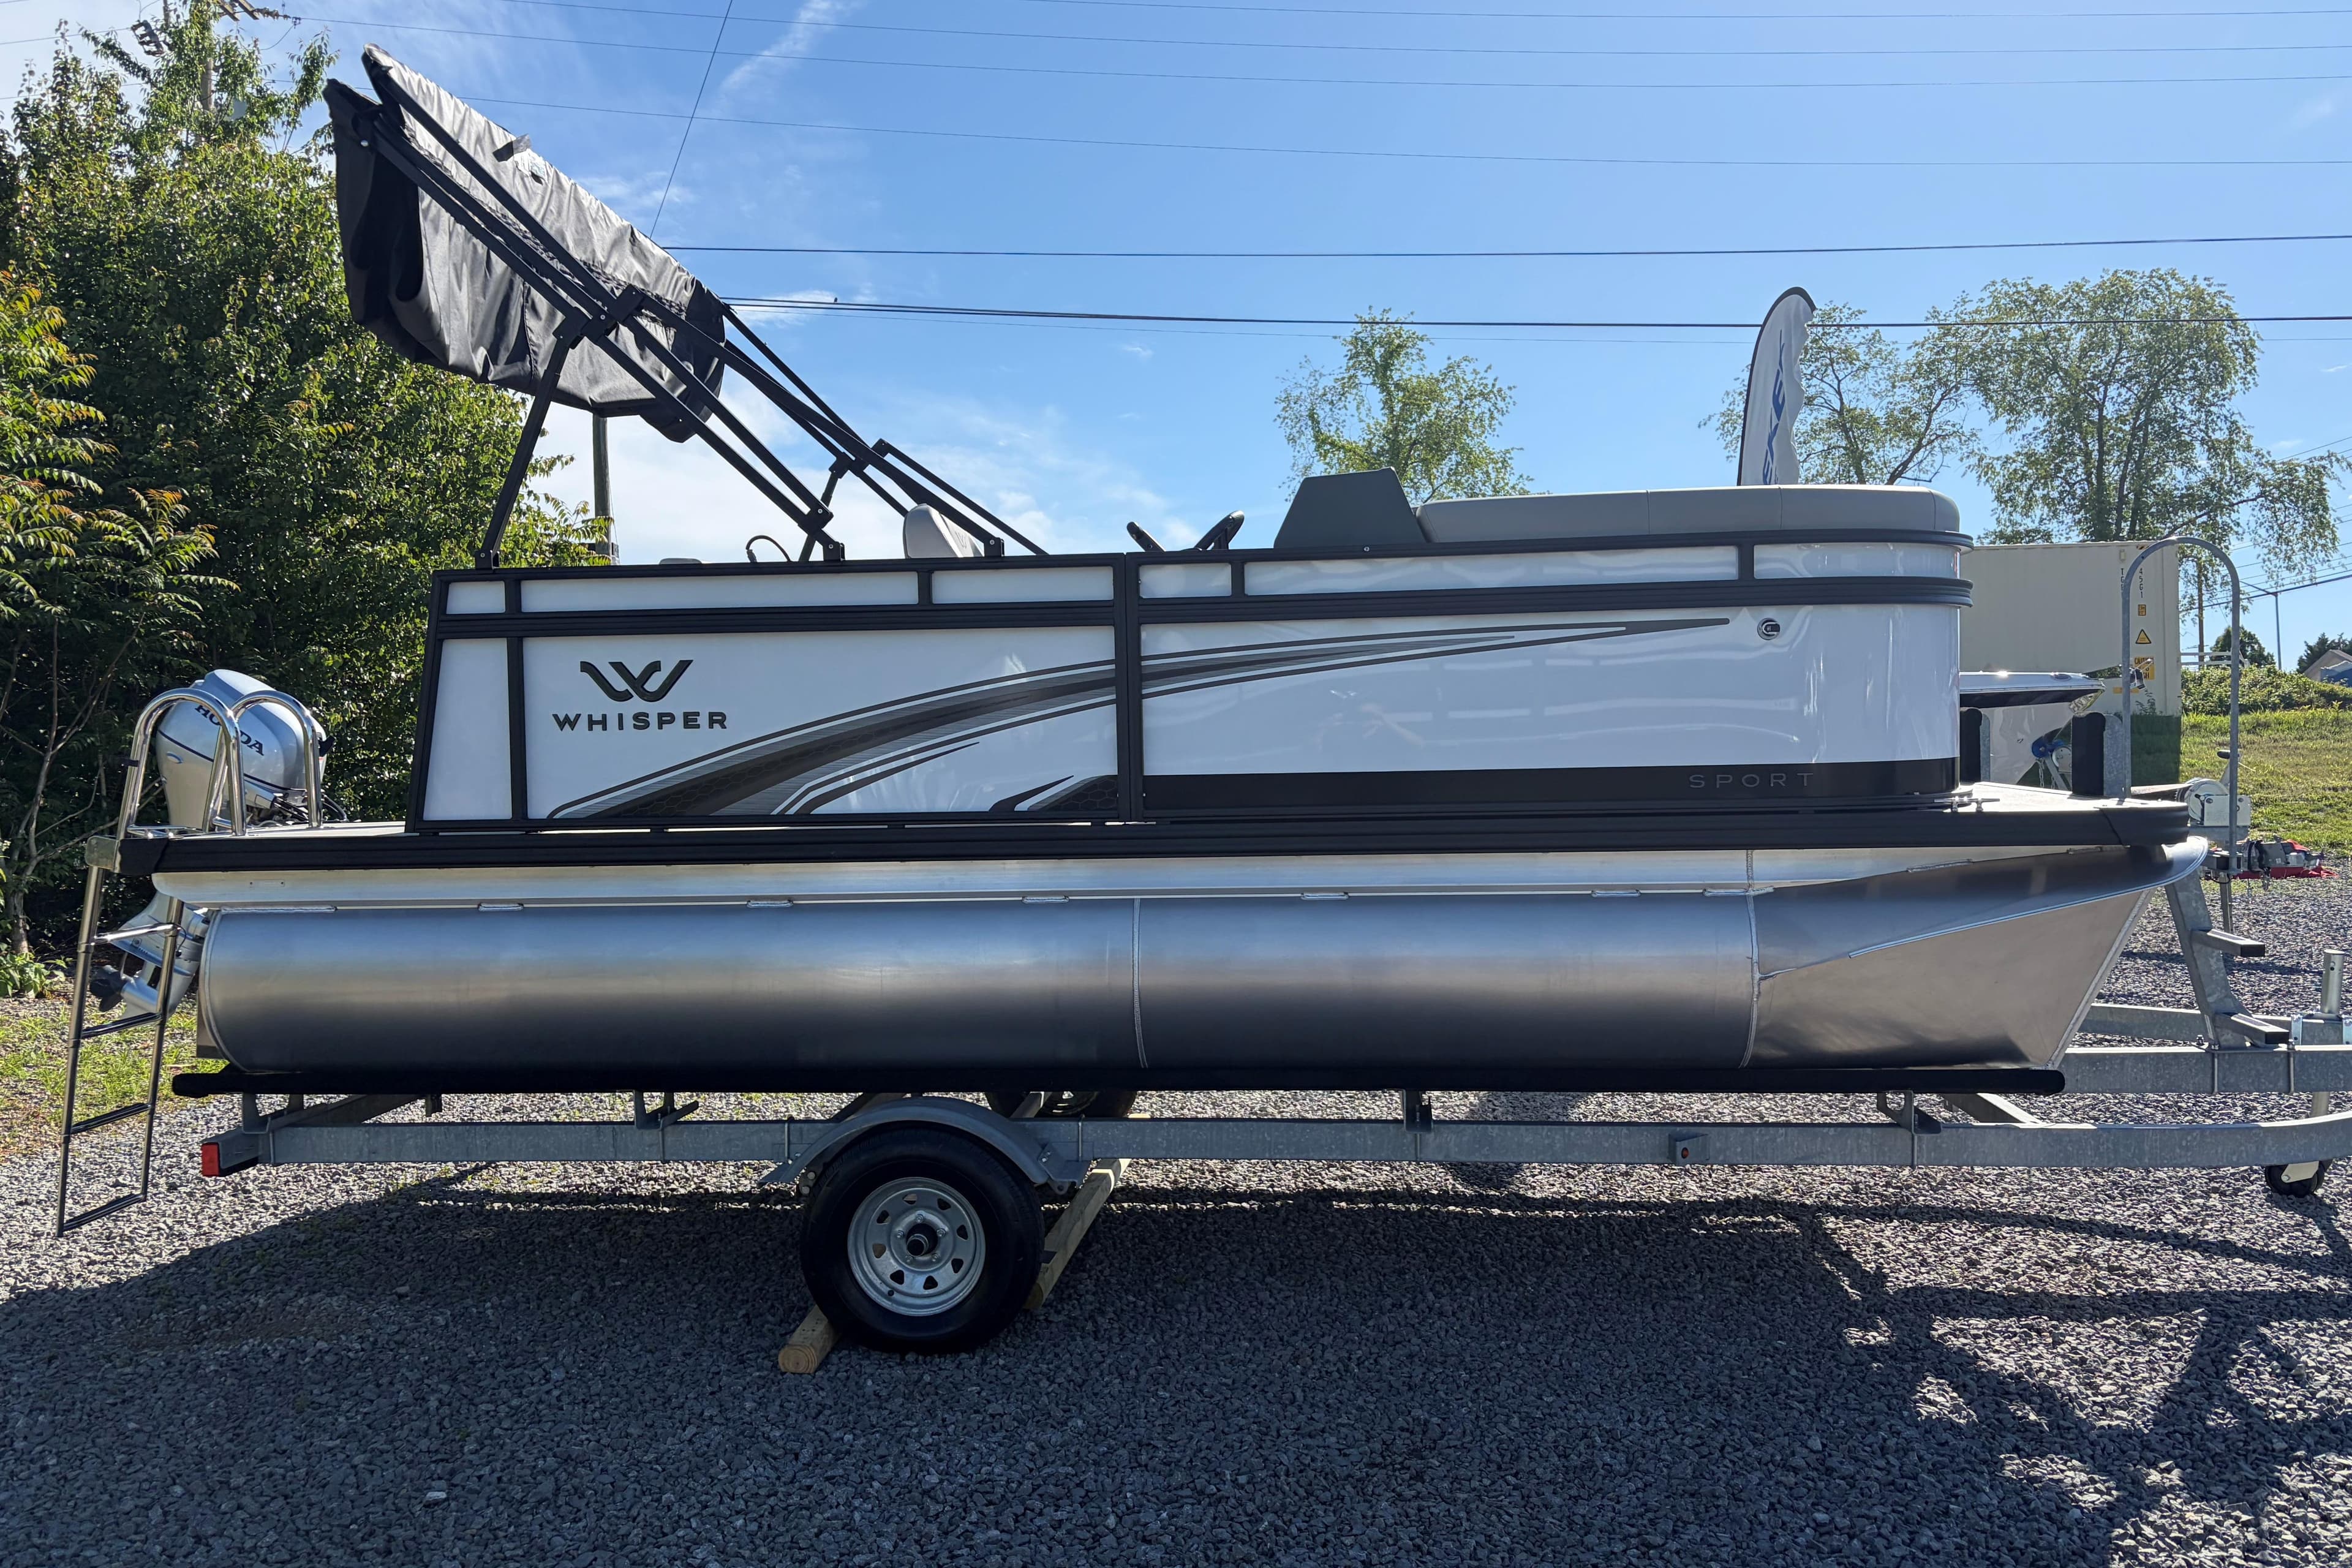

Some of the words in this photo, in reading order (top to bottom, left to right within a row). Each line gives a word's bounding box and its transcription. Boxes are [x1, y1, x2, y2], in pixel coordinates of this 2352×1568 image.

[194, 704, 265, 756] HODA
[552, 710, 728, 732] WHISPER
[1689, 772, 1814, 789] SPORT
